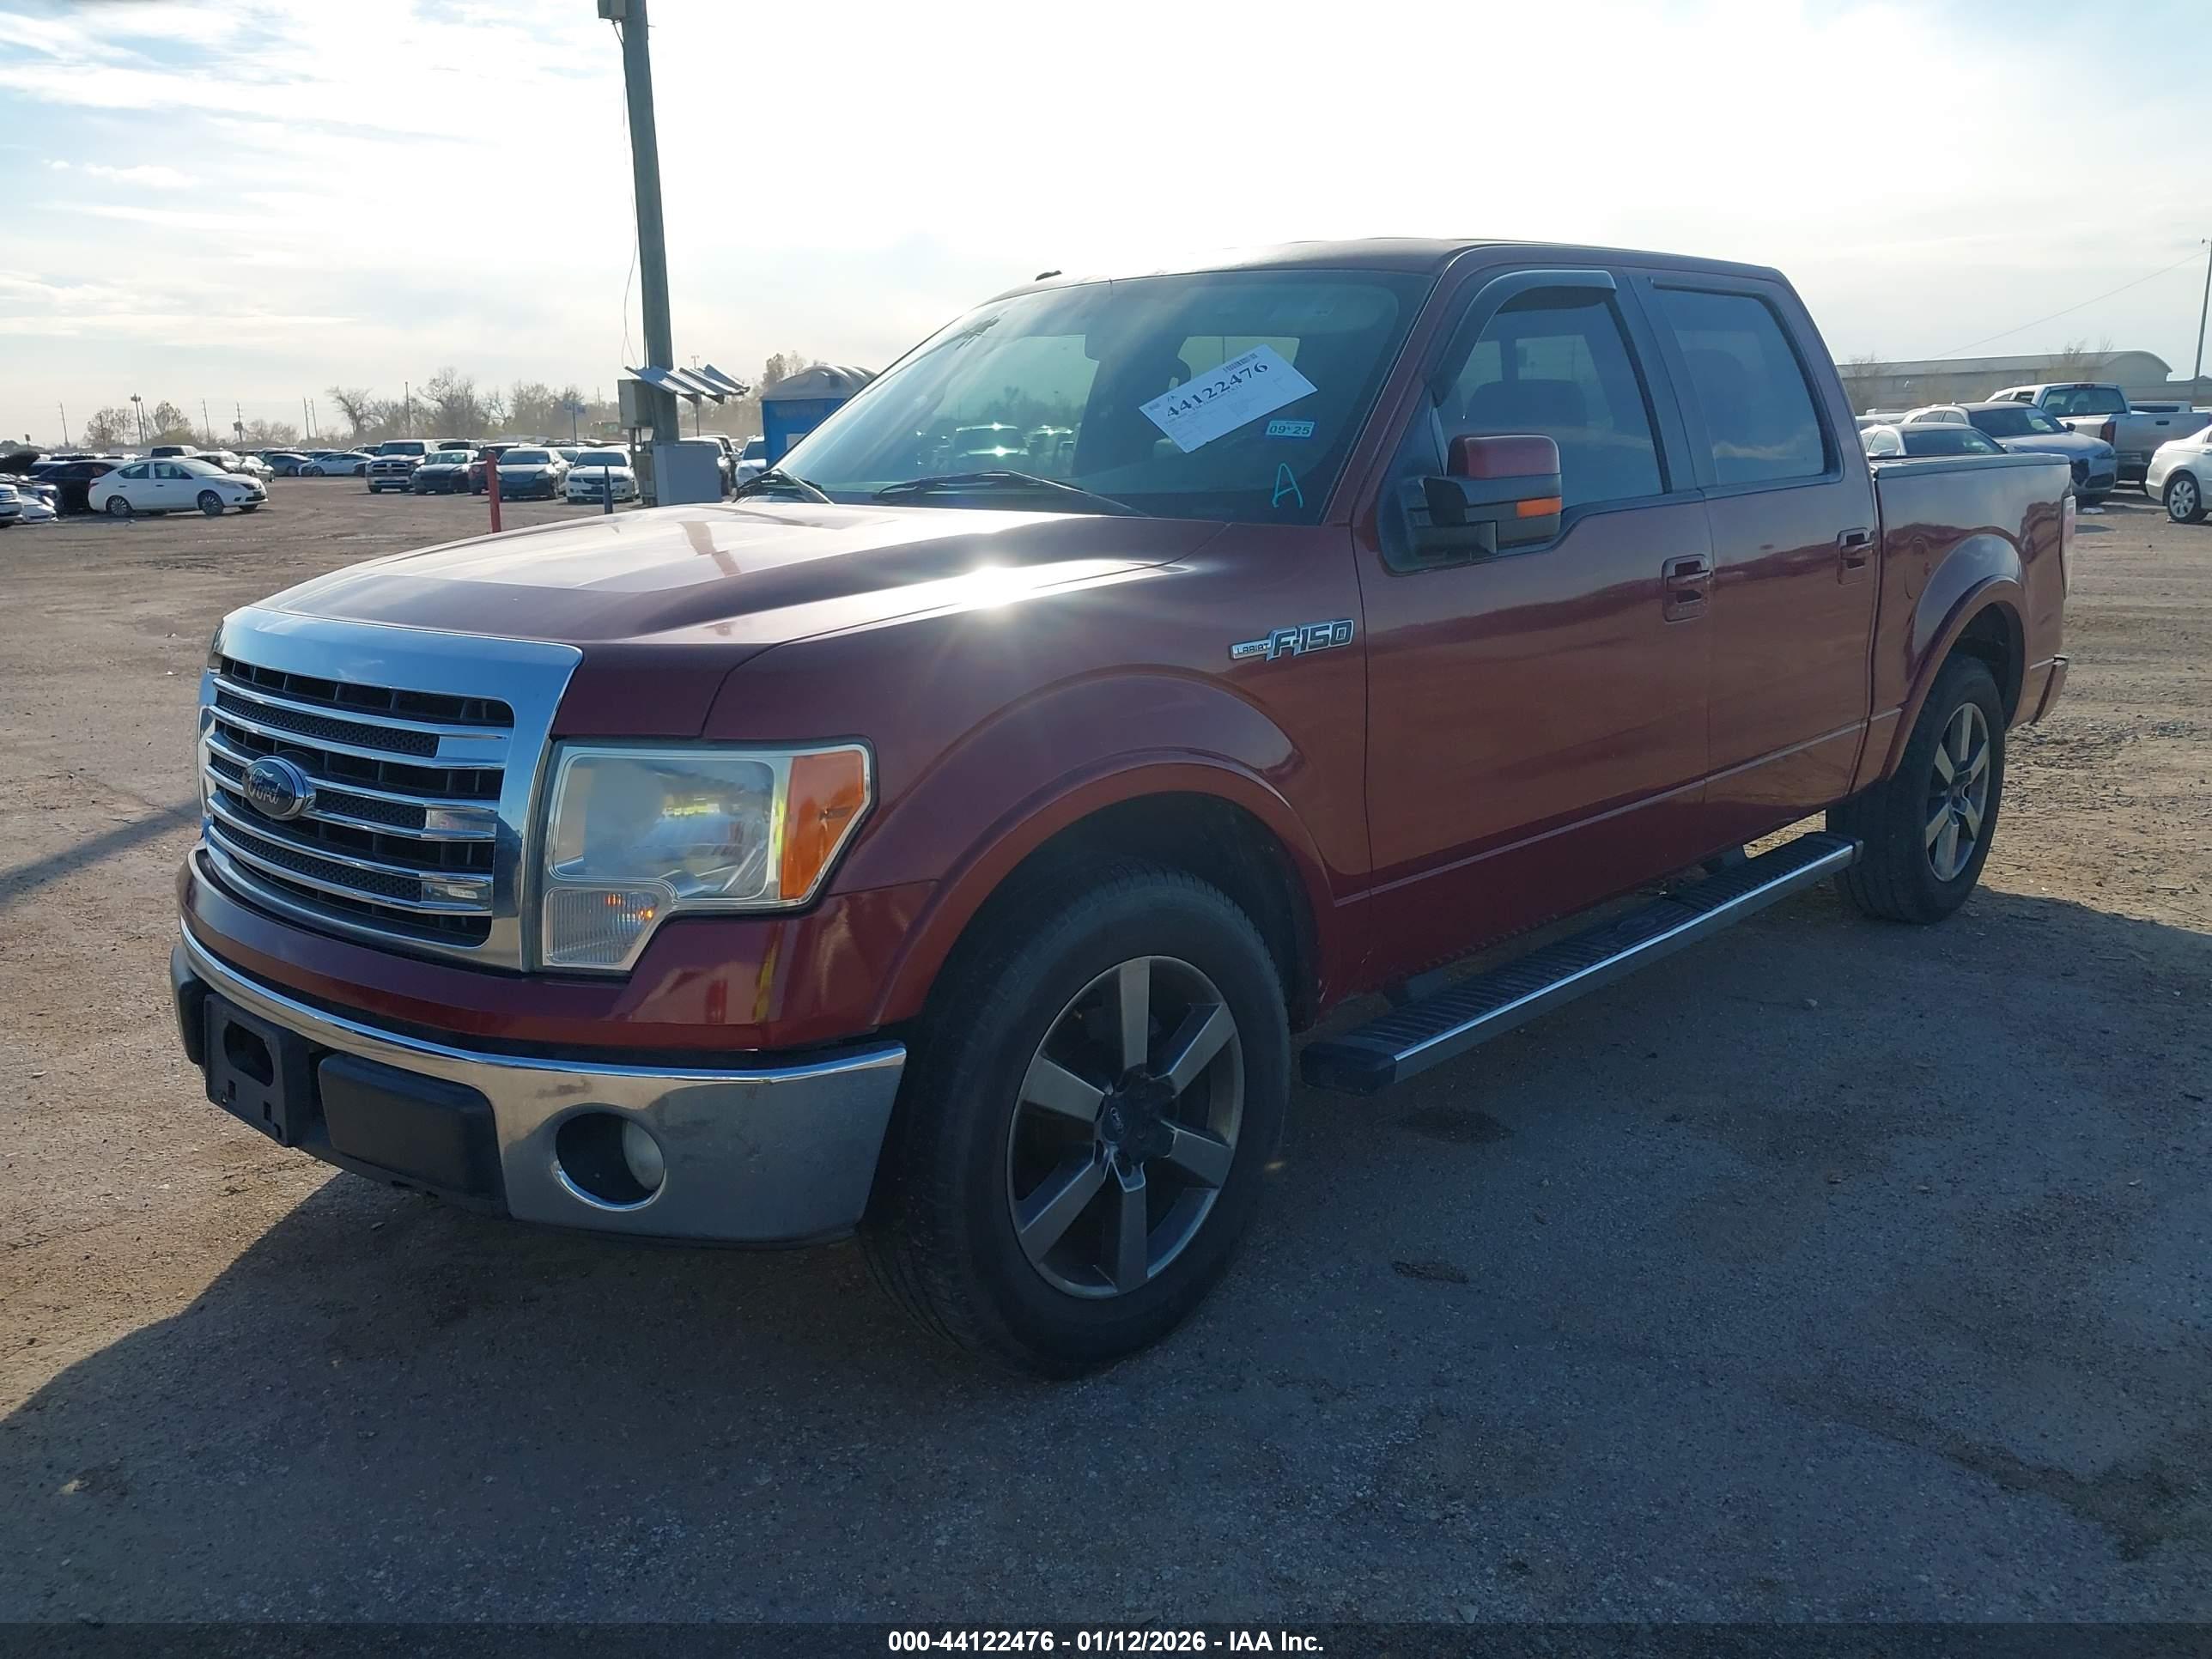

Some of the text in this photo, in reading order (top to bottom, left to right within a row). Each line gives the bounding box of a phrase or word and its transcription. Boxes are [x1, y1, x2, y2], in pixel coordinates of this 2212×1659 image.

[1167, 362, 1268, 418] 44122476
[1269, 425, 1310, 434] 09 25
[1272, 463, 1304, 508] A
[1268, 619, 1354, 659] F-150
[248, 767, 282, 805] Ford
